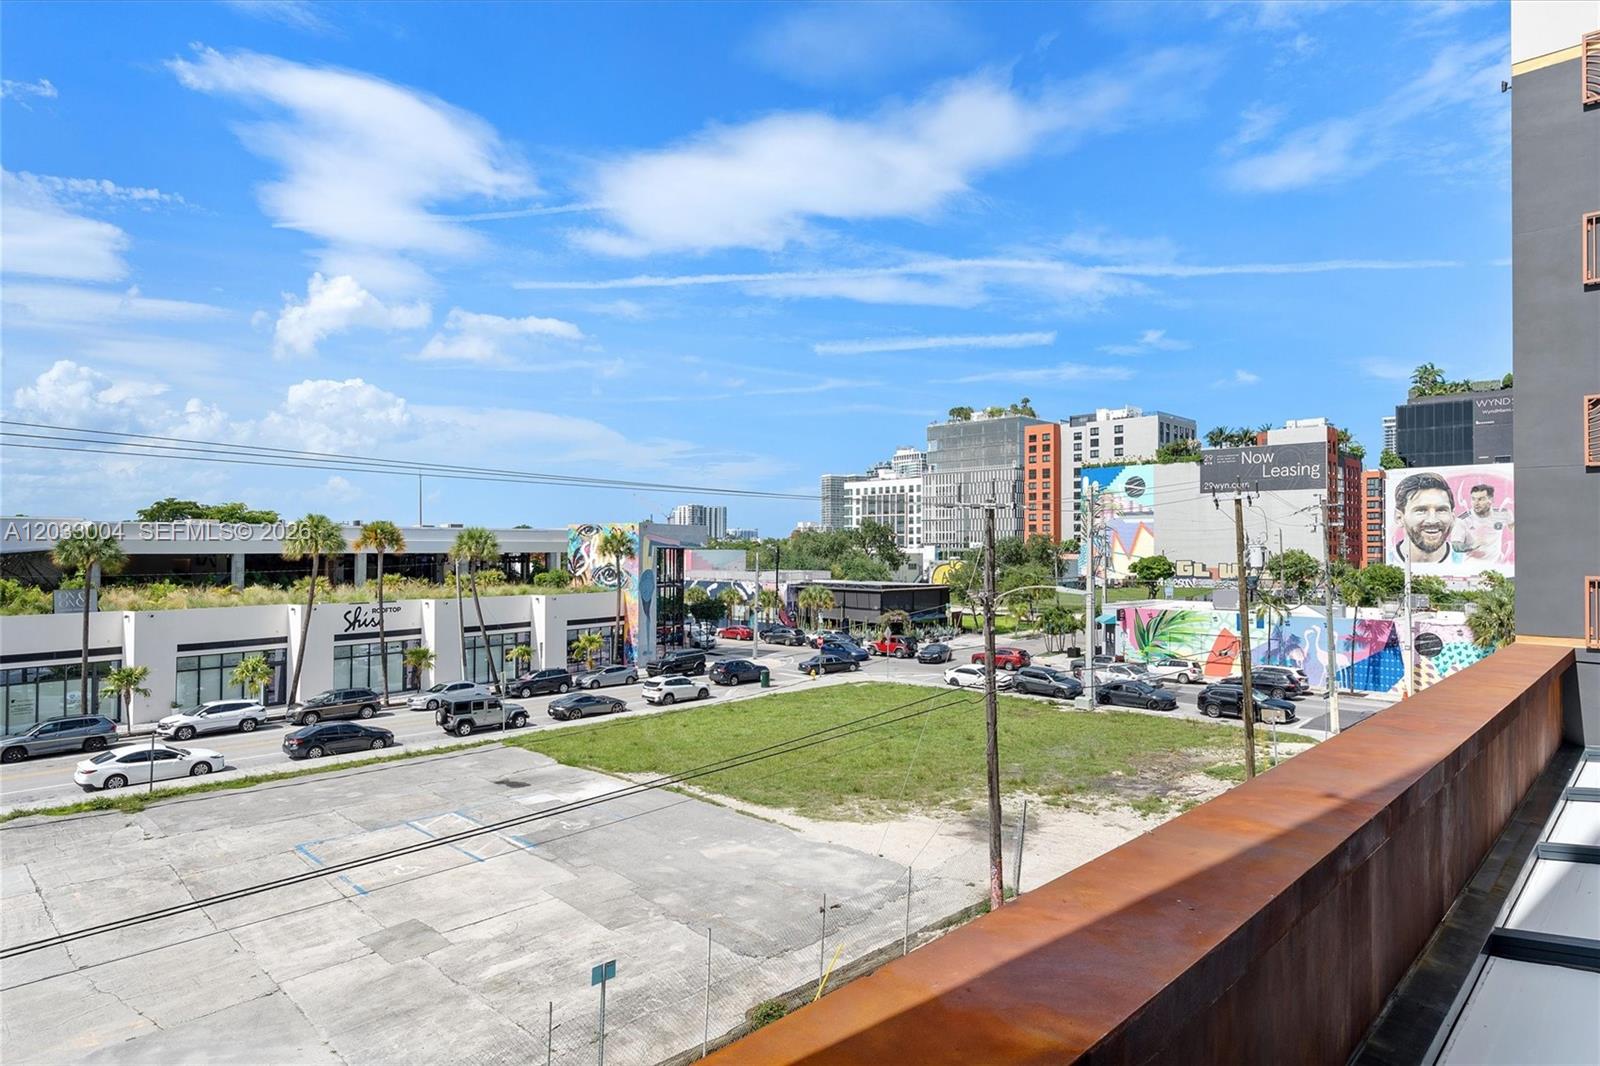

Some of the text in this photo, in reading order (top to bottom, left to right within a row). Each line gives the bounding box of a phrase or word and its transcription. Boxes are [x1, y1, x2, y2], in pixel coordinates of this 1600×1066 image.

[1476, 397, 1513, 408] WYND
[1241, 451, 1274, 464] Now
[1262, 462, 1320, 479] Leasing
[343, 606, 383, 632] Shis
